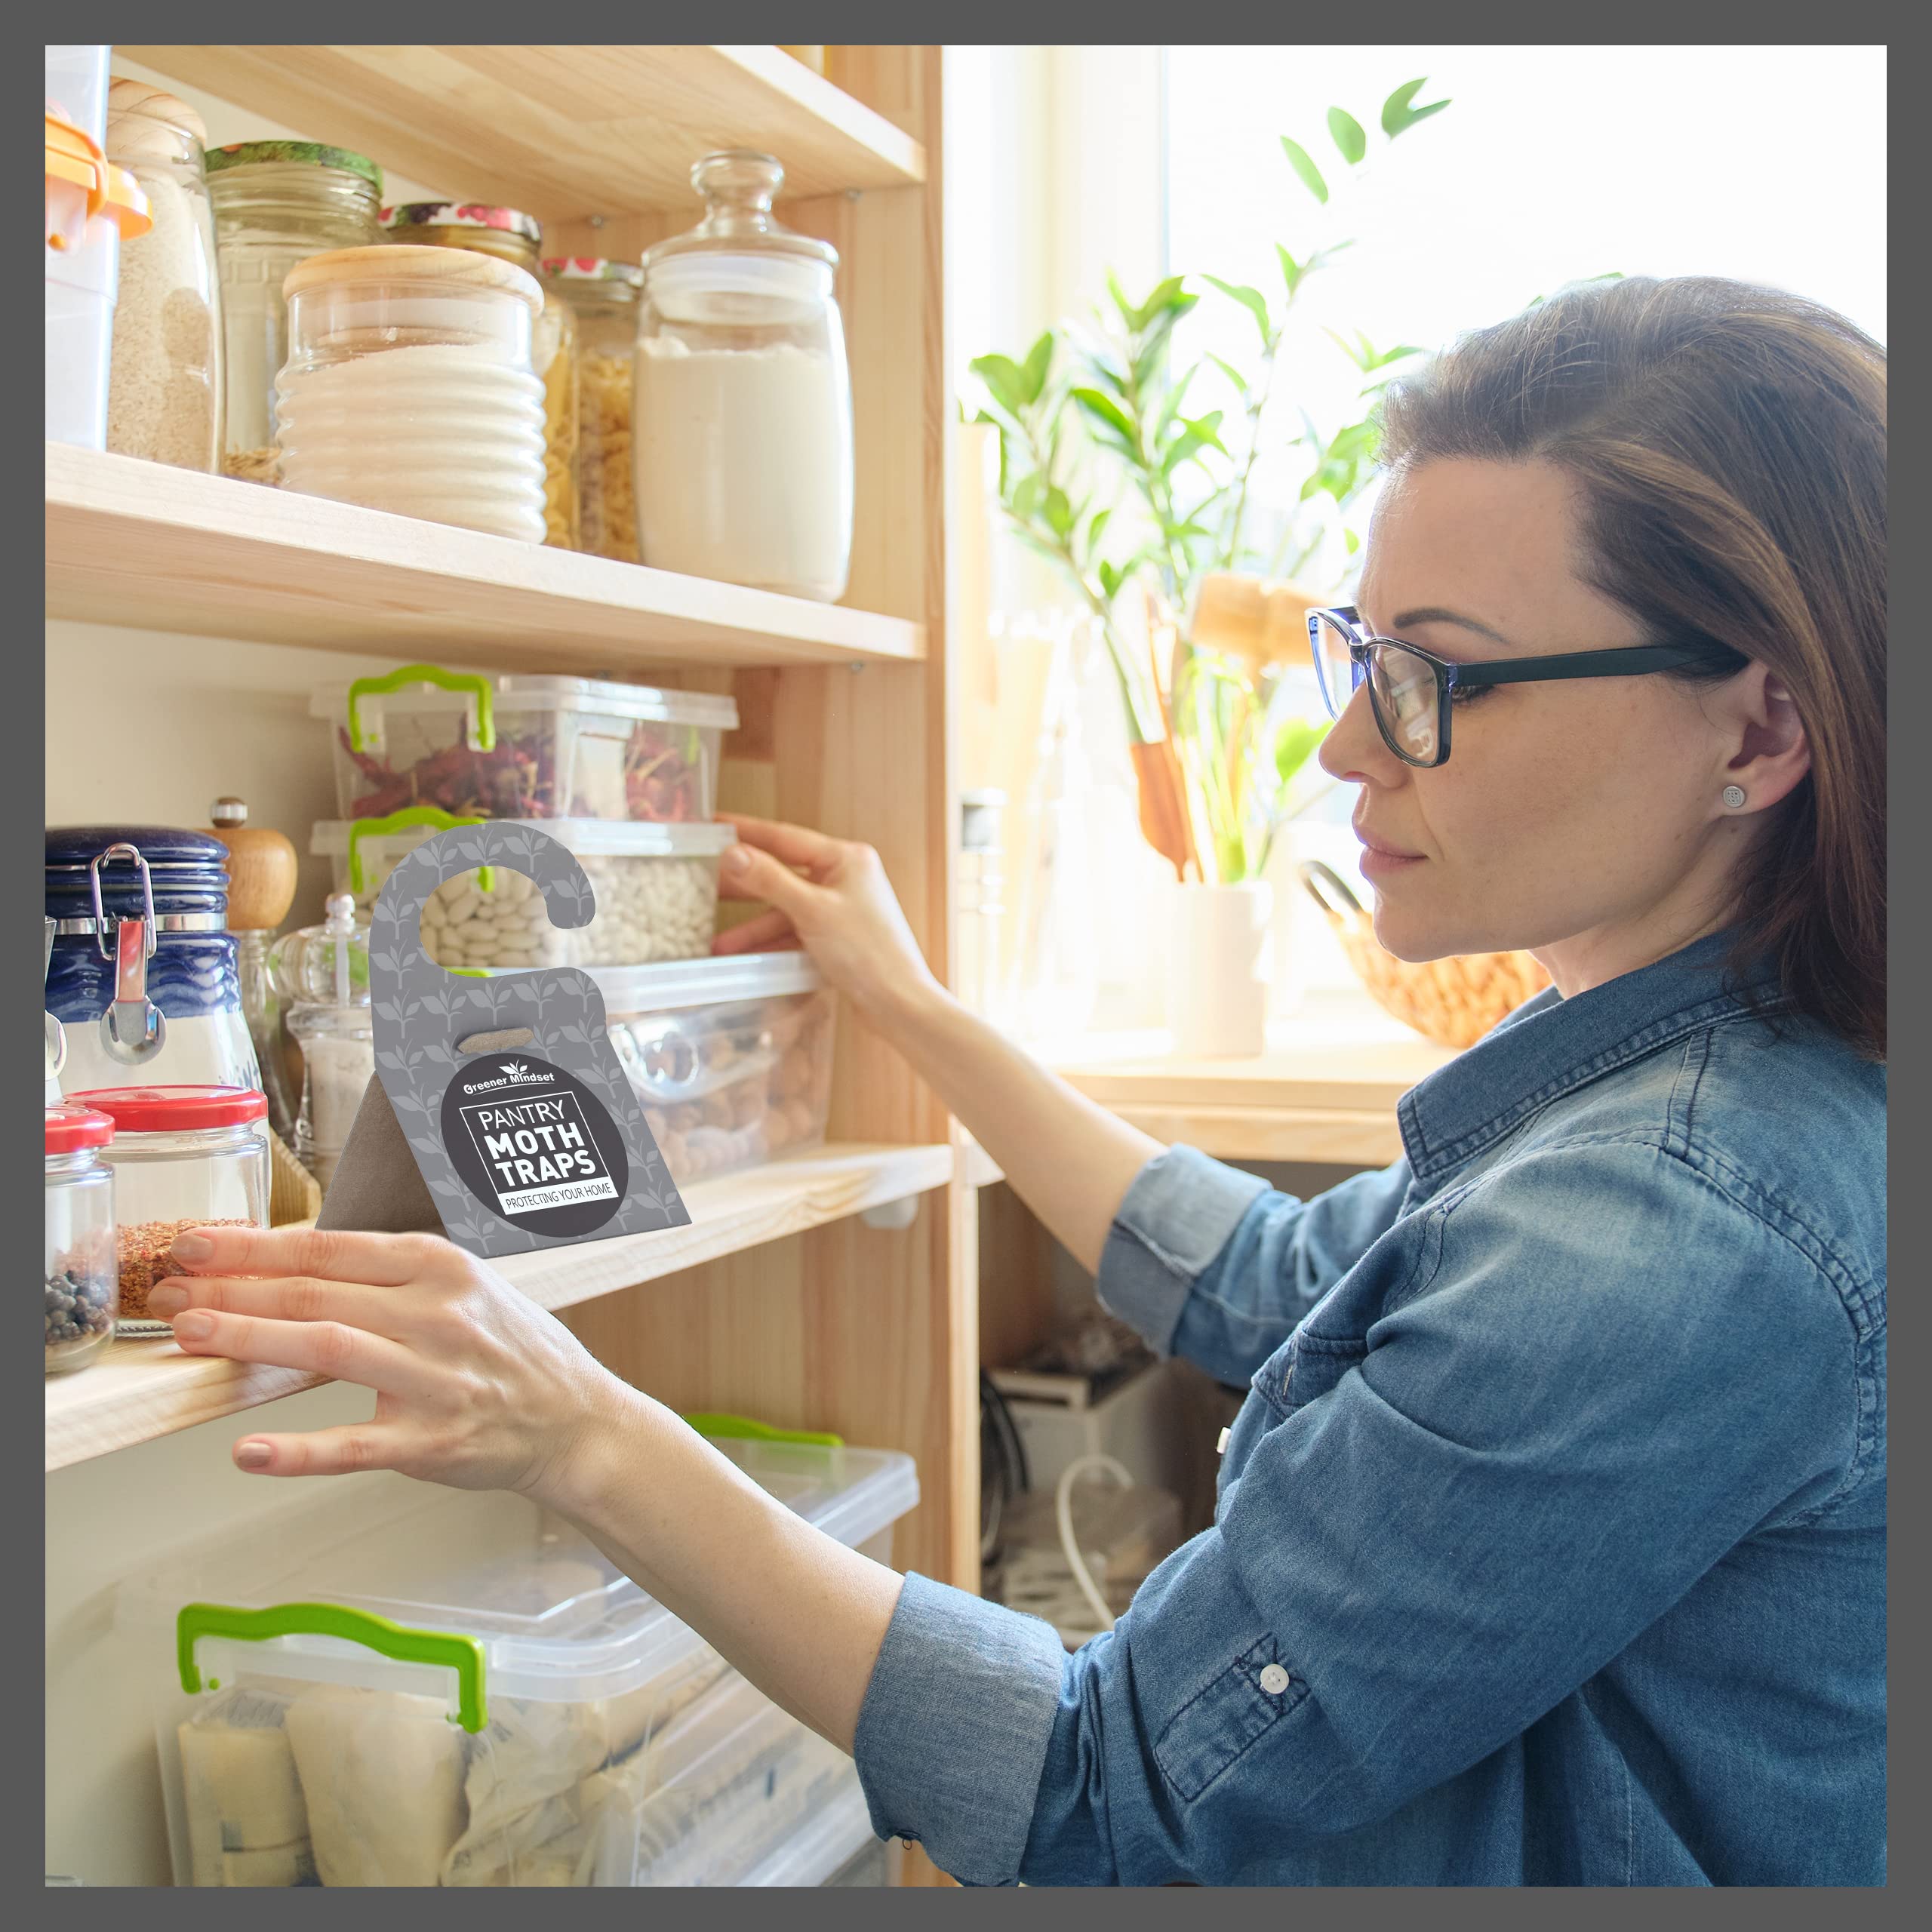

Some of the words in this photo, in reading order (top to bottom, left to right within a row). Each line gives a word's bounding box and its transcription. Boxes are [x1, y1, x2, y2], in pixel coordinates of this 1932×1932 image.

[463, 1077, 507, 1094] Greener
[509, 1072, 555, 1084] Mindset
[478, 1100, 565, 1131] PANTRY
[484, 1122, 585, 1160] MOTH
[494, 1149, 596, 1187] TRAPS
[505, 1191, 559, 1209] PROTECTING
[558, 1186, 585, 1201] YOUR
[585, 1183, 613, 1196] HOME
